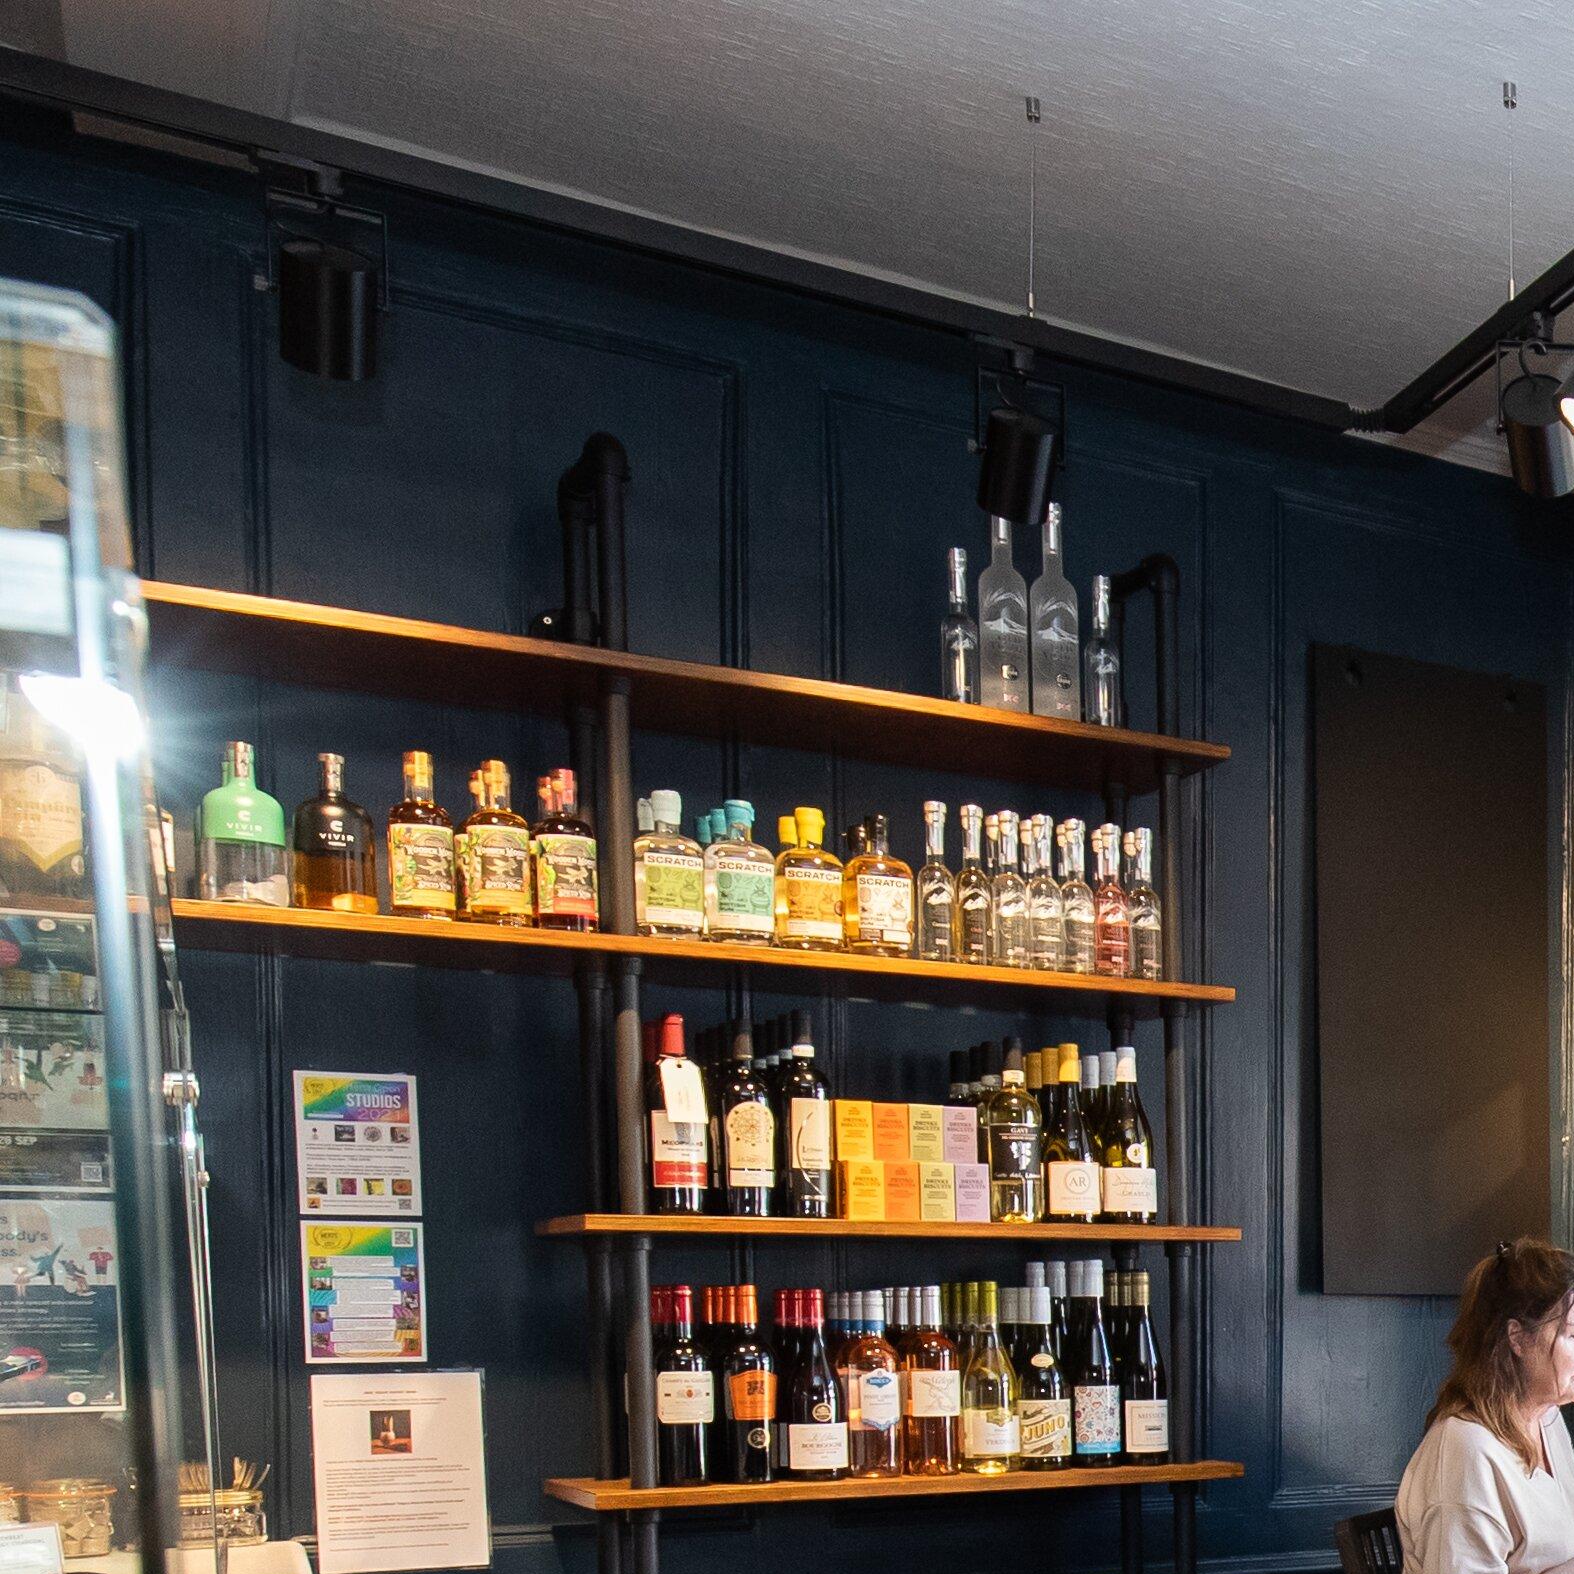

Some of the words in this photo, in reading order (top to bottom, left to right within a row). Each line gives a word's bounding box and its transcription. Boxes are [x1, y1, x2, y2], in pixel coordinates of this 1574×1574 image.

[226, 822, 263, 831] VIVIR
[318, 832, 355, 843] VIVIR
[647, 855, 702, 867] SCRATCH
[719, 862, 772, 873] SCRATCH
[787, 870, 840, 881] SCRATCH
[859, 878, 909, 888] SCRATCH
[346, 1094, 401, 1109] STUDIOS
[14, 1136, 38, 1145] SEP
[1070, 1176, 1087, 1187] AR
